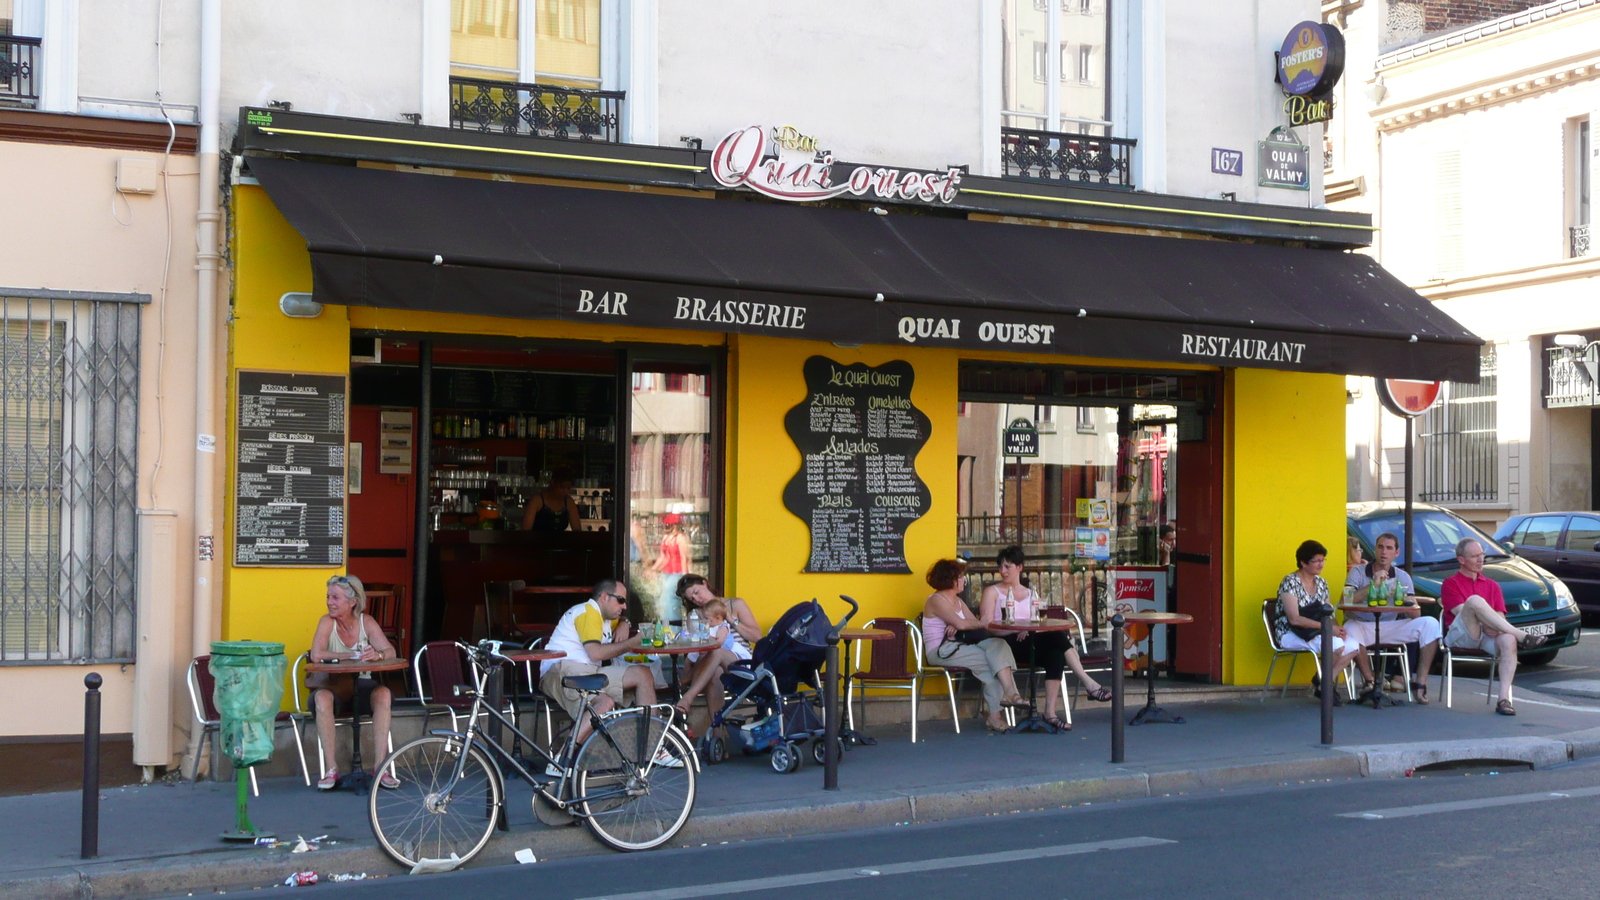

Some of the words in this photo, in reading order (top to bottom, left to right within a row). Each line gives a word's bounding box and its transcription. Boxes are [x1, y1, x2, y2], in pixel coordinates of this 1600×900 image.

[1281, 46, 1323, 68] FOSTER'S
[1283, 95, 1328, 125] Bar
[776, 125, 819, 152] Bar
[711, 125, 842, 200] Quai
[849, 166, 961, 203] ouest
[1215, 150, 1240, 172] 167
[1272, 150, 1297, 162] QUAI
[1266, 168, 1302, 182] VALMY
[576, 289, 628, 316] BAR
[674, 296, 807, 329] BRASSERIE
[898, 316, 961, 342] QUAI
[978, 322, 1055, 344] OUEST
[1181, 334, 1306, 363] RESTAURANT
[828, 365, 843, 386] Le
[845, 370, 870, 388] Quai
[821, 435, 880, 456] Salades
[817, 494, 853, 508] Plats
[1544, 624, 1554, 634] 75
